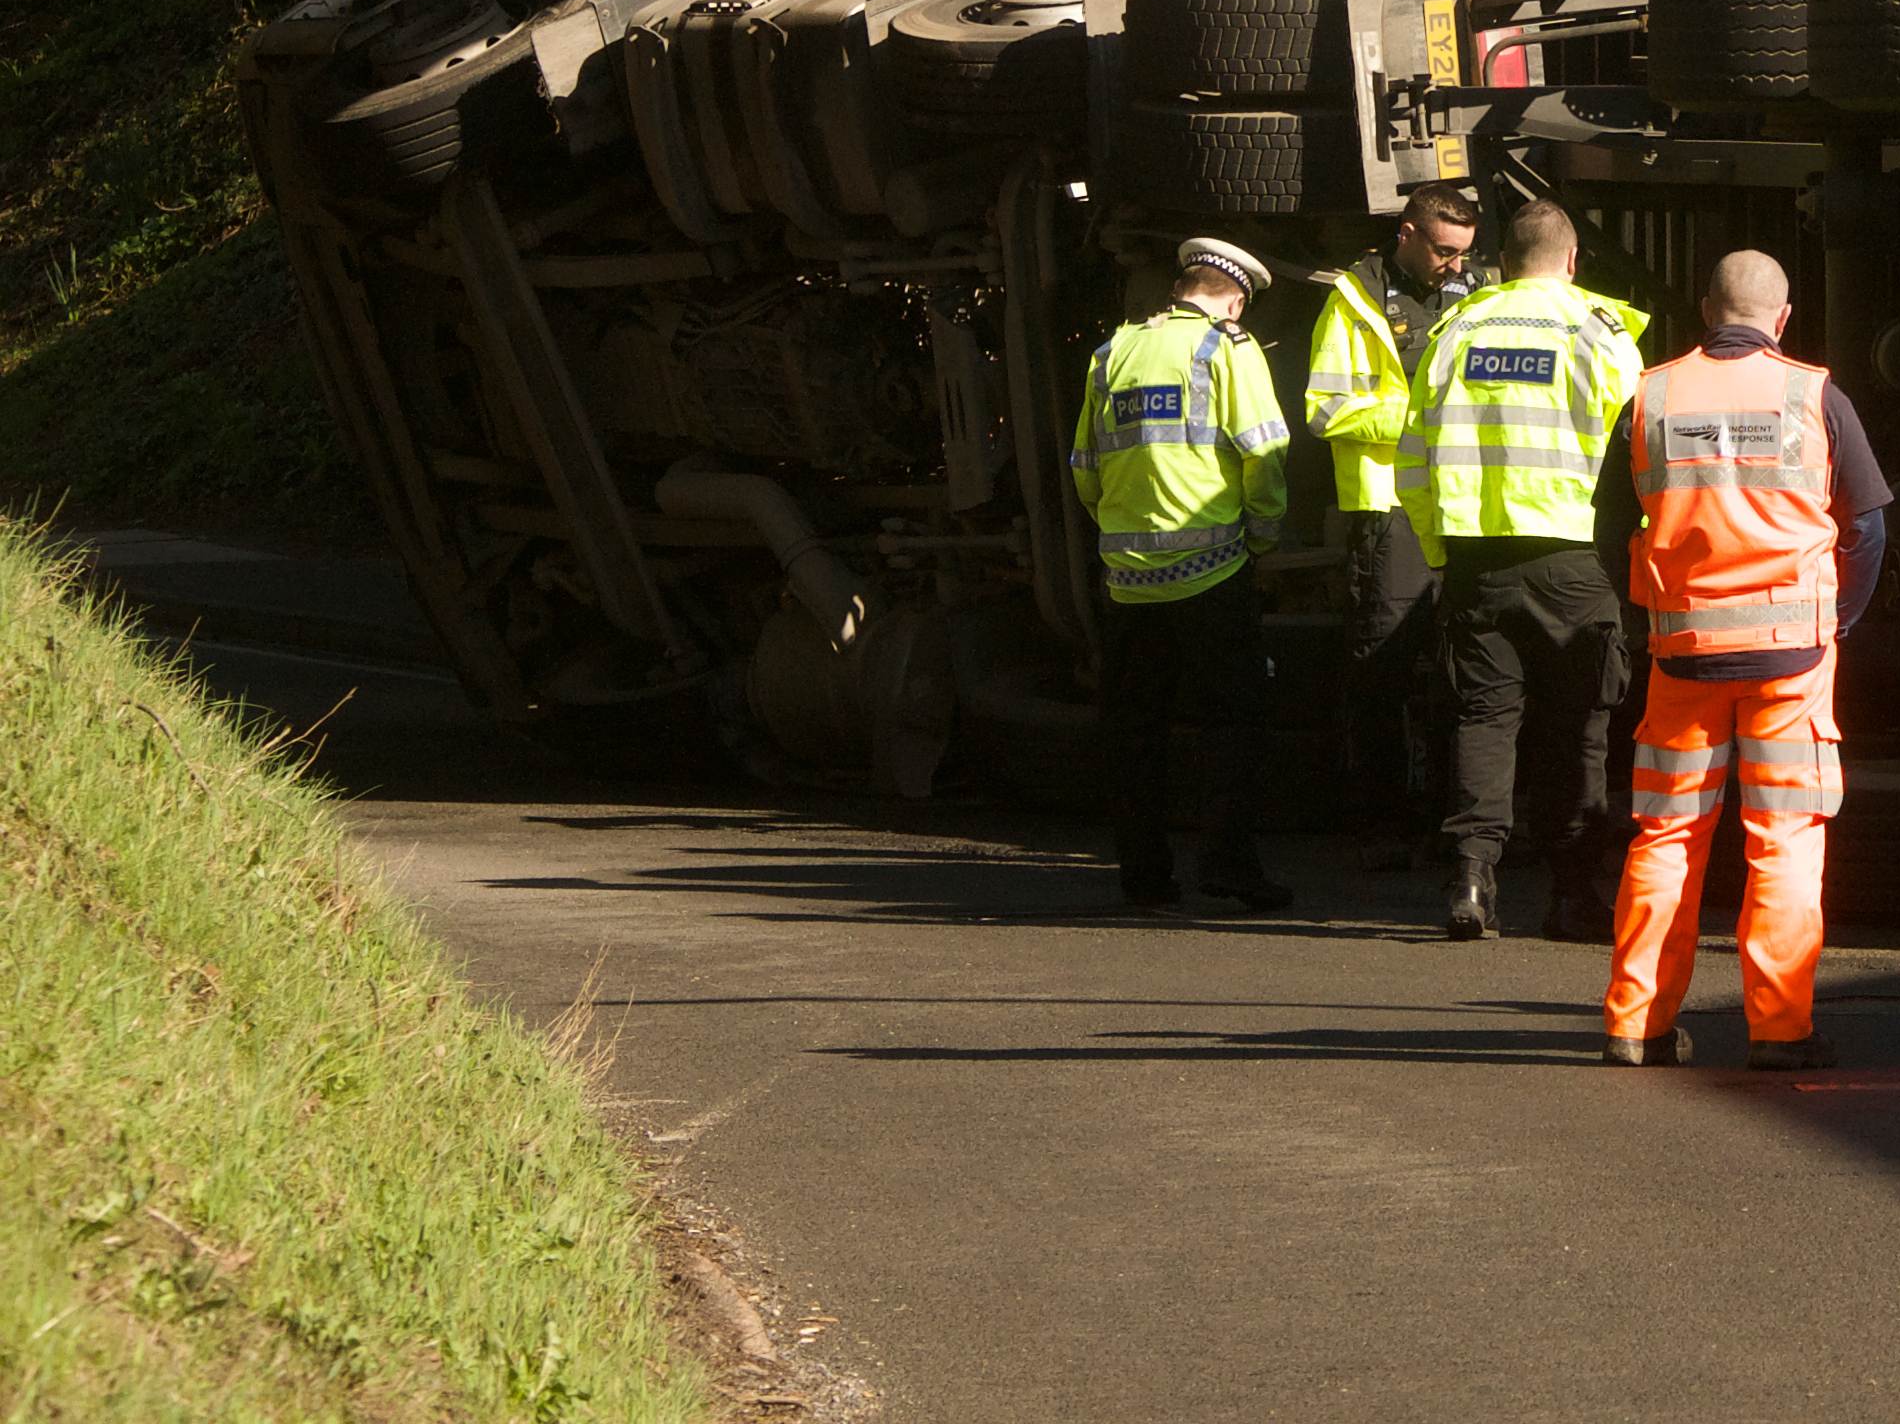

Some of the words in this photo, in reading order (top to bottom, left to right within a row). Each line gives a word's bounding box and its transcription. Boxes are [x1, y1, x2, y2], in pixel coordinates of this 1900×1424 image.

[1469, 354, 1551, 375] POLICE
[1115, 393, 1178, 418] POLICE
[1728, 425, 1772, 433] INCIDENT
